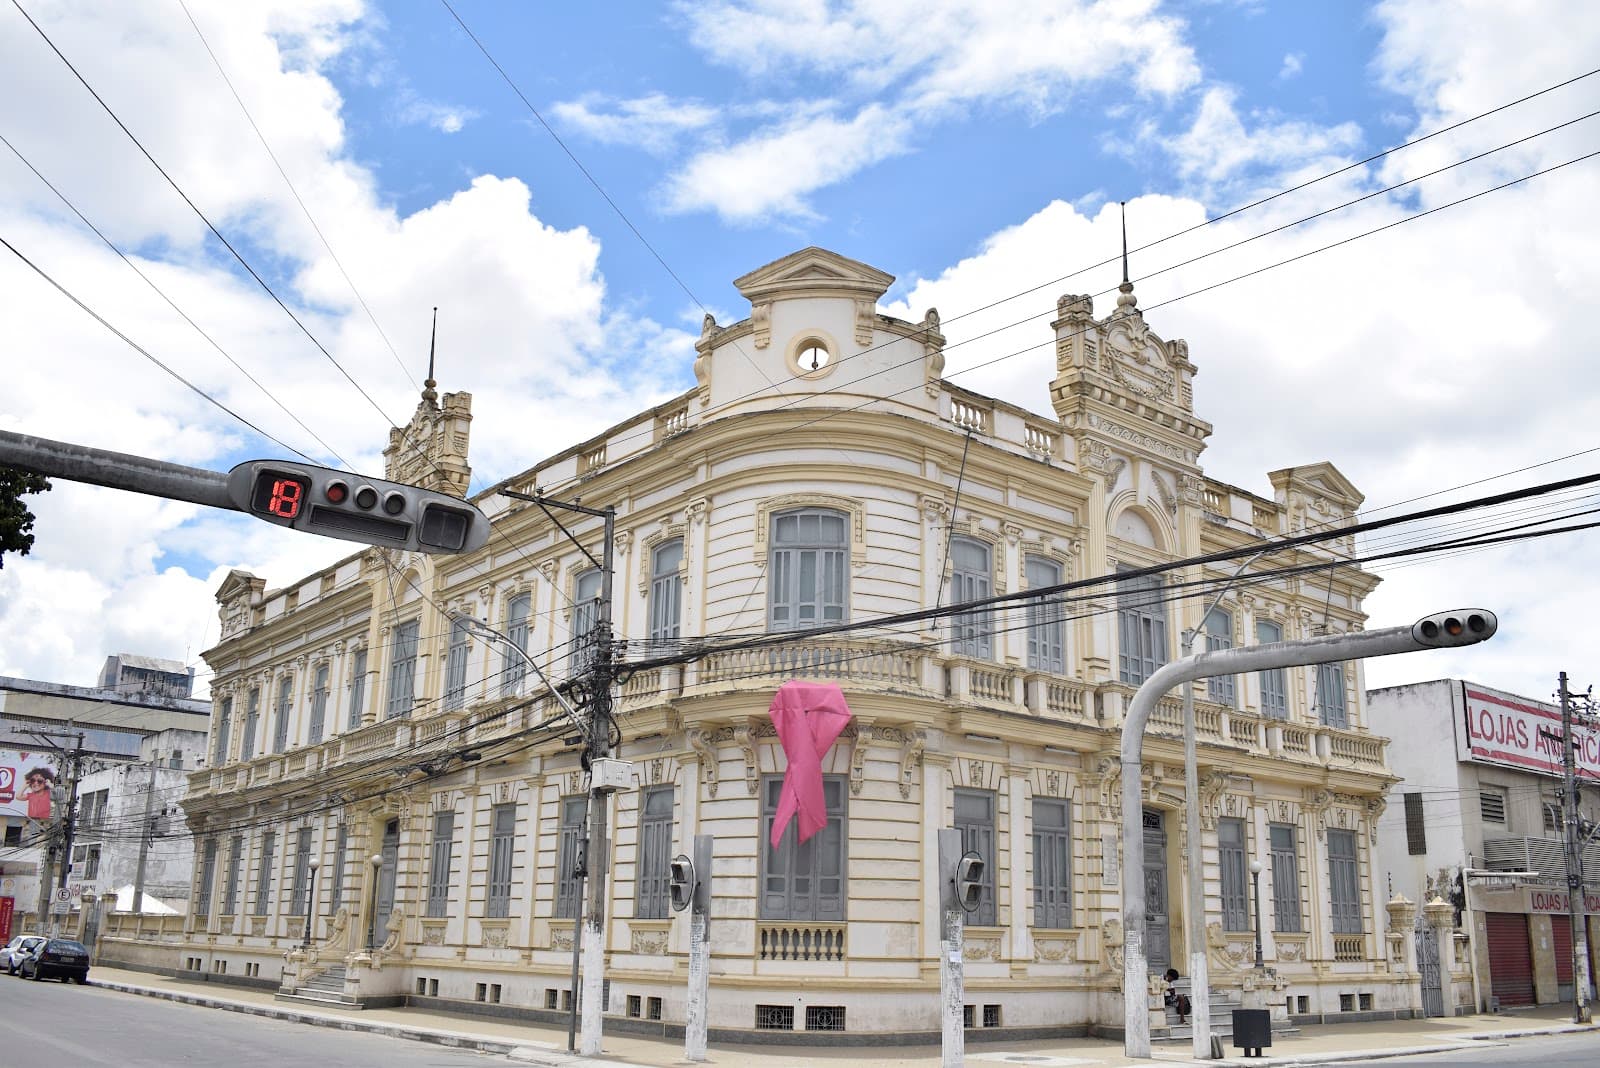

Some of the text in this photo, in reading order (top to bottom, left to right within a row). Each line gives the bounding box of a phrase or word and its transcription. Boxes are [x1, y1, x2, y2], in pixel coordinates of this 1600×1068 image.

[269, 479, 301, 519] 18
[1468, 706, 1529, 749] LOJAS
[1531, 891, 1561, 911] LOJAS
